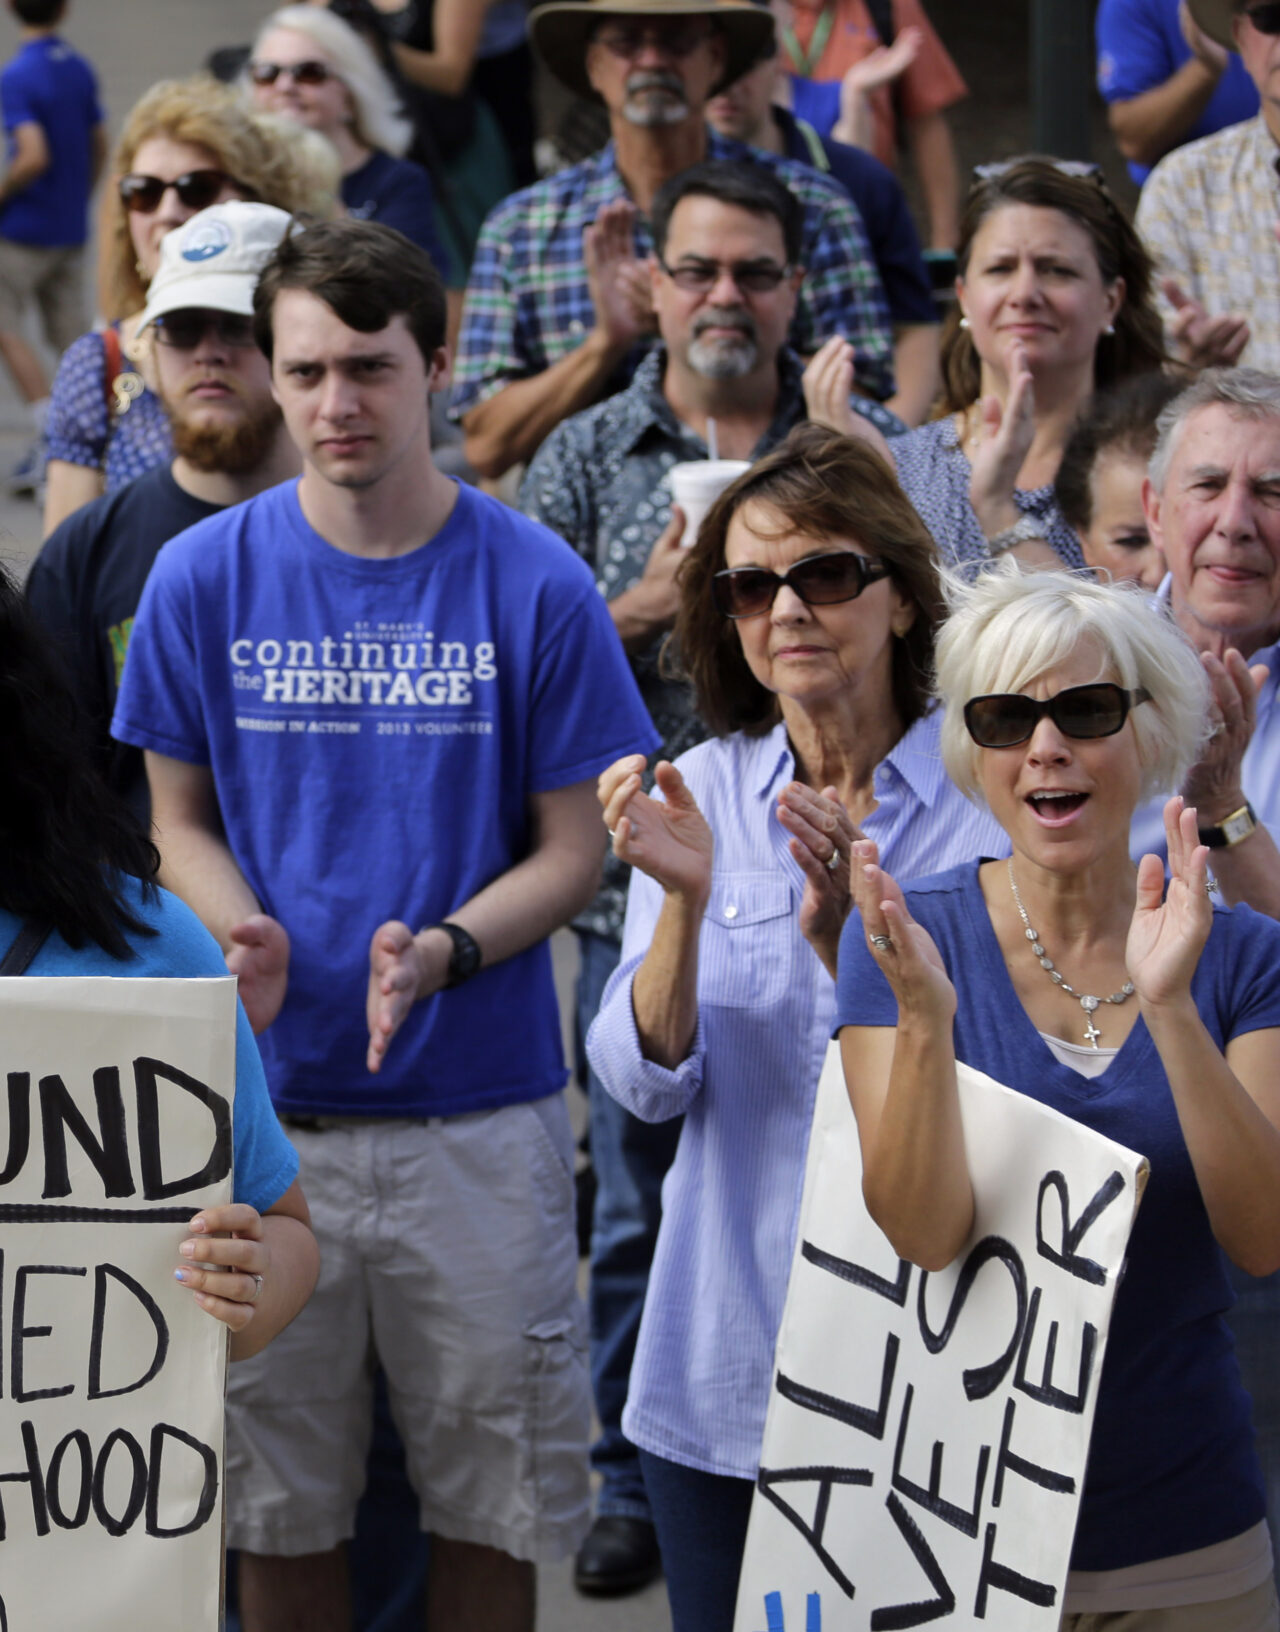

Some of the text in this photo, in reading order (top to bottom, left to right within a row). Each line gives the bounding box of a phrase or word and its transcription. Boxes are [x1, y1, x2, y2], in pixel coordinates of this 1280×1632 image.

[229, 634, 498, 681] continuing
[232, 667, 473, 705] the HERITAGE
[307, 720, 361, 734] ACTION
